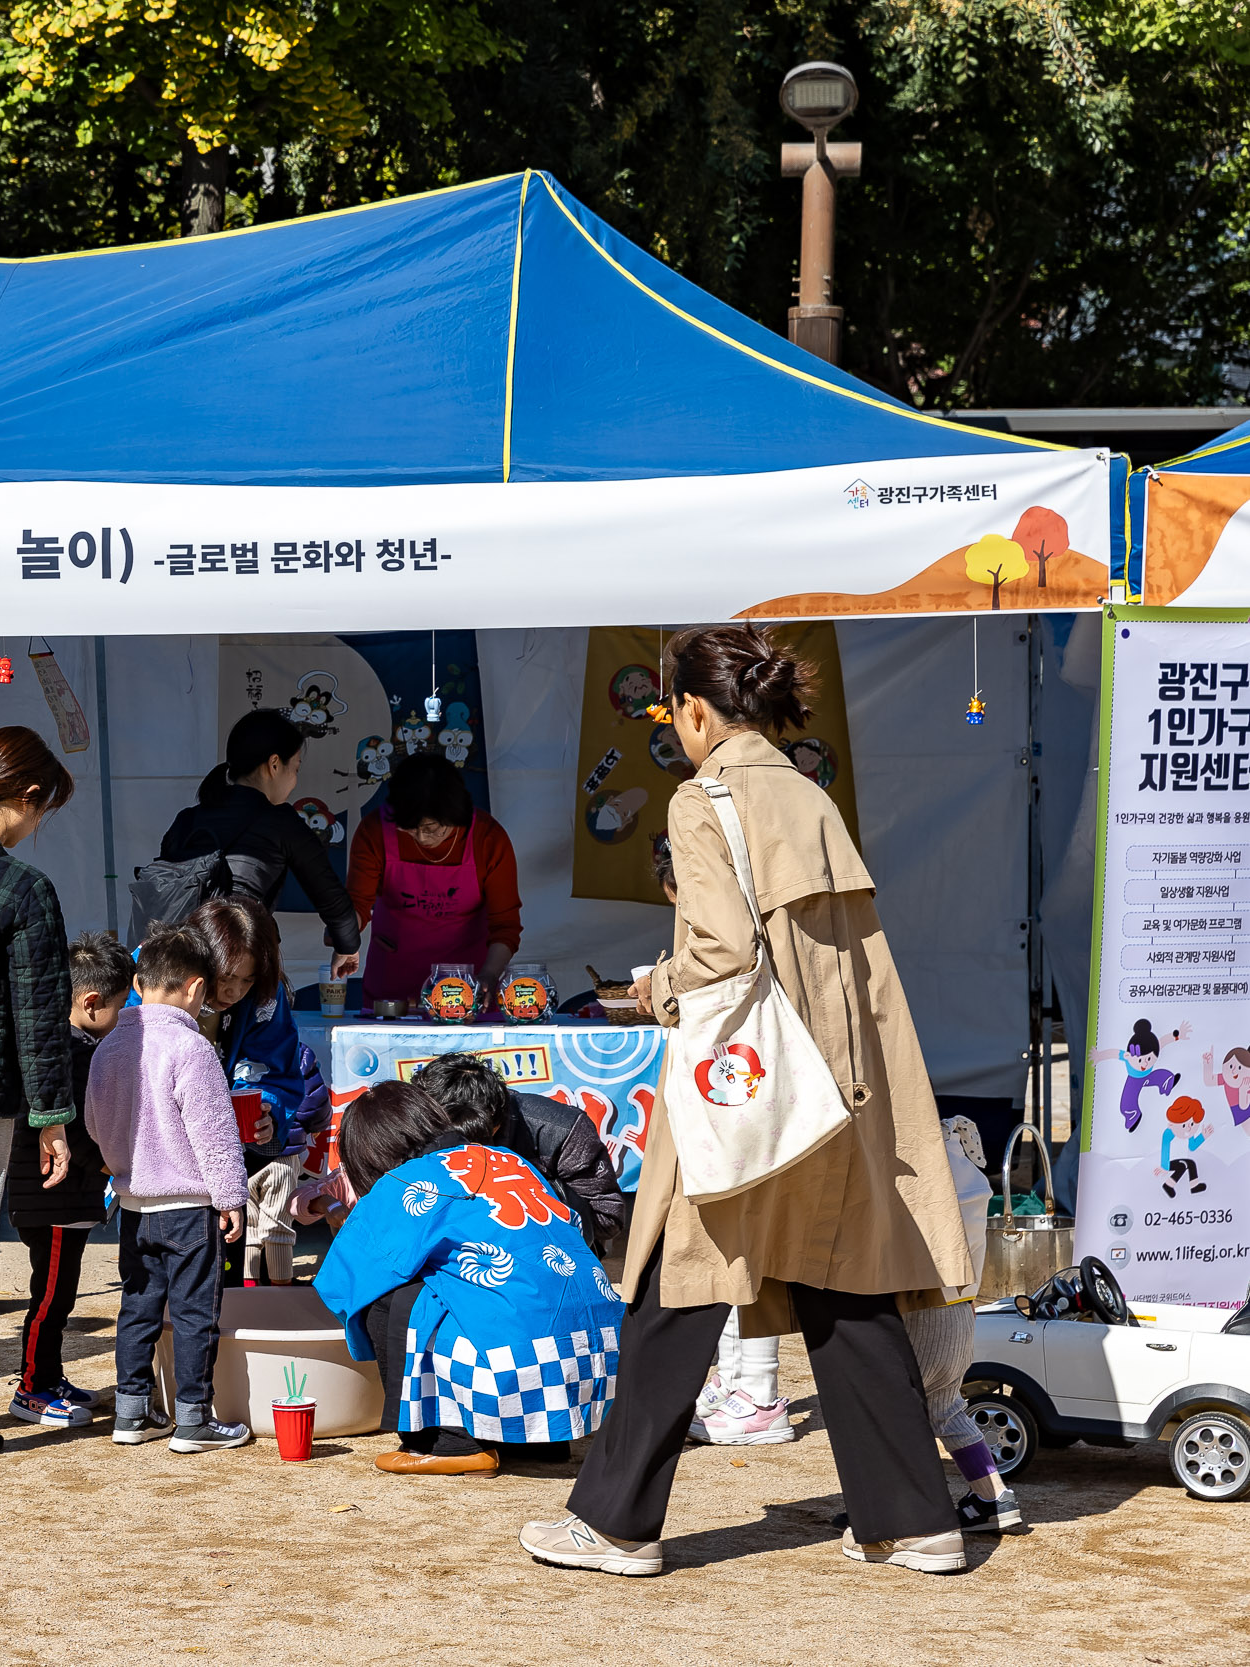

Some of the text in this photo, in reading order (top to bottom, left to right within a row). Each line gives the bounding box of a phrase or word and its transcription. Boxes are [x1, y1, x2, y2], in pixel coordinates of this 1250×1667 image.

[877, 484, 998, 505] 광진구가족센터
[16, 527, 134, 584] 놀이)
[154, 537, 452, 576] -글로벌 문화와 청년-
[1158, 662, 1250, 702] 광진구
[1148, 707, 1250, 747] 1인가구
[1115, 812, 1155, 825] 1인가구의
[1158, 812, 1184, 825] 건강한
[1186, 812, 1203, 825] 삶과
[1207, 811, 1231, 825] 행복을
[1152, 851, 1242, 865] 자기돌봄 역량강화 사업
[1160, 884, 1230, 899] 일상생활 지원사업
[1142, 917, 1243, 932] 교육 및 여가문화 프로그램
[1147, 949, 1236, 964] 사회적 관계망 지원사업
[1128, 981, 1249, 998] 공유사업(공간대관 및 물품대여)
[1144, 1208, 1233, 1227] 02-465-0336
[1136, 1243, 1250, 1264] www.1lifegj.or.kr
